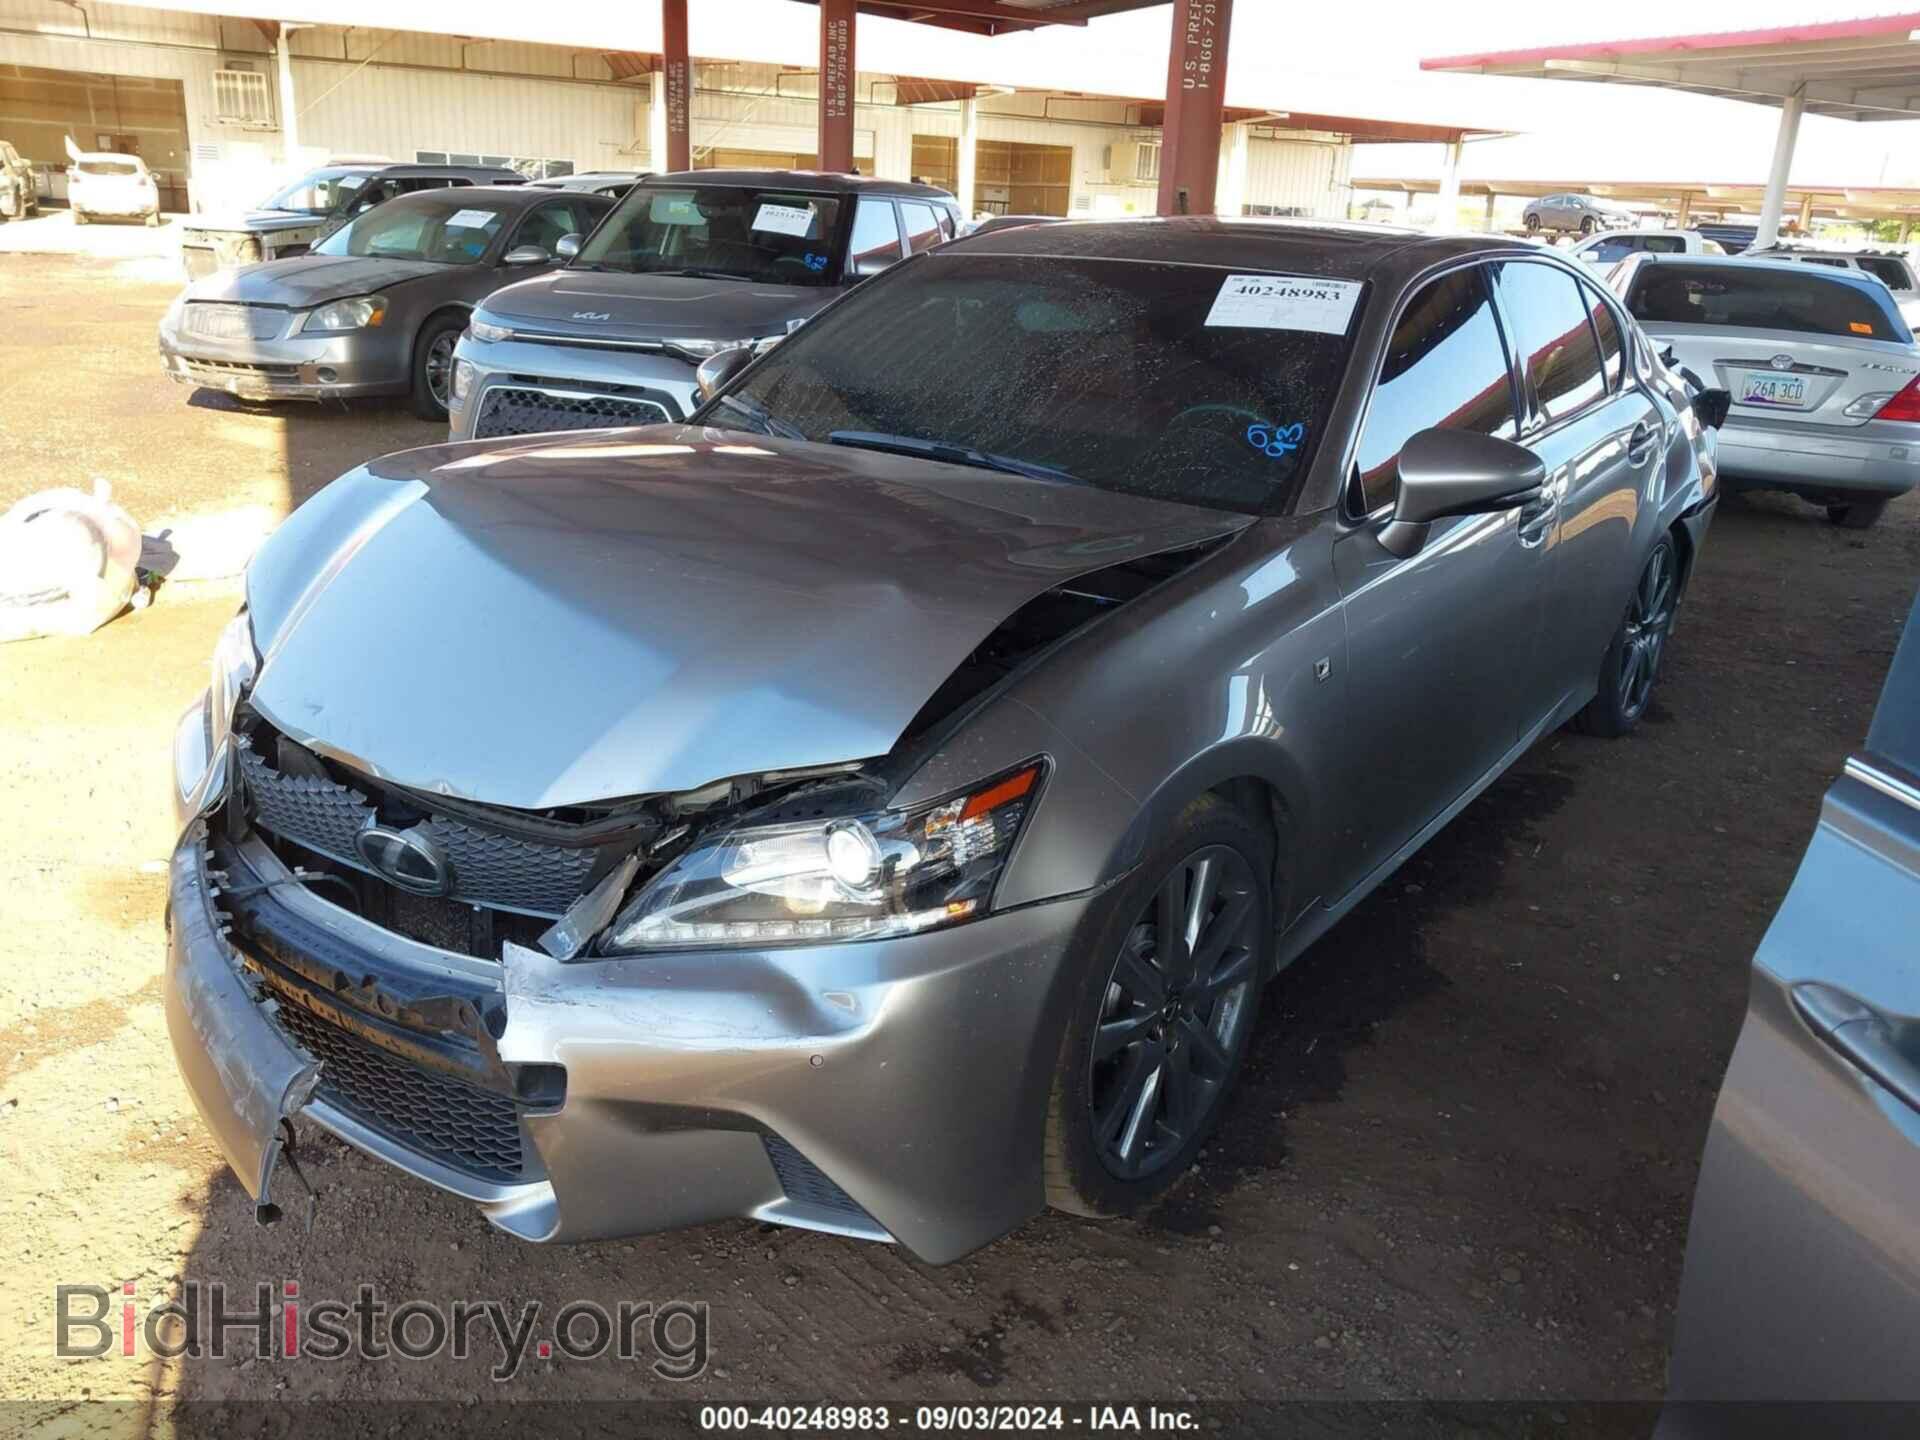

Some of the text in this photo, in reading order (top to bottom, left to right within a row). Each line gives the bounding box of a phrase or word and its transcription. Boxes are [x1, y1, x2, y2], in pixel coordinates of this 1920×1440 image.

[828, 21, 838, 41] INC
[1198, 0, 1216, 88] 1-866-79
[1183, 55, 1198, 89] U.S.
[1234, 285, 1341, 301] 40248983
